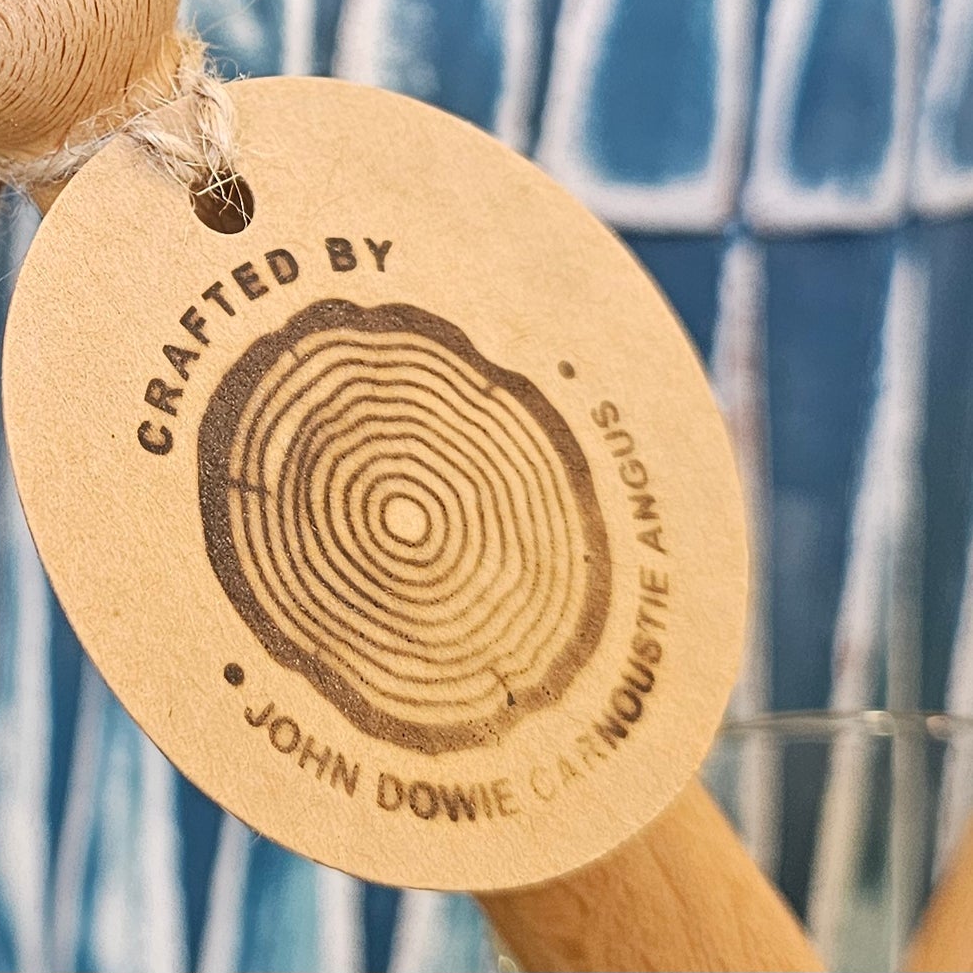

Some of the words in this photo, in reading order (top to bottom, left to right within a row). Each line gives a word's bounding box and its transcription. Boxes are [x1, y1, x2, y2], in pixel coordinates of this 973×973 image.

[137, 247, 300, 456] CRAFTED
[325, 236, 393, 272] BY
[591, 399, 669, 555] ANGUS
[245, 701, 360, 799] JOHN
[530, 565, 669, 802] CARNOUSTIE
[376, 772, 516, 821] DOWIE
